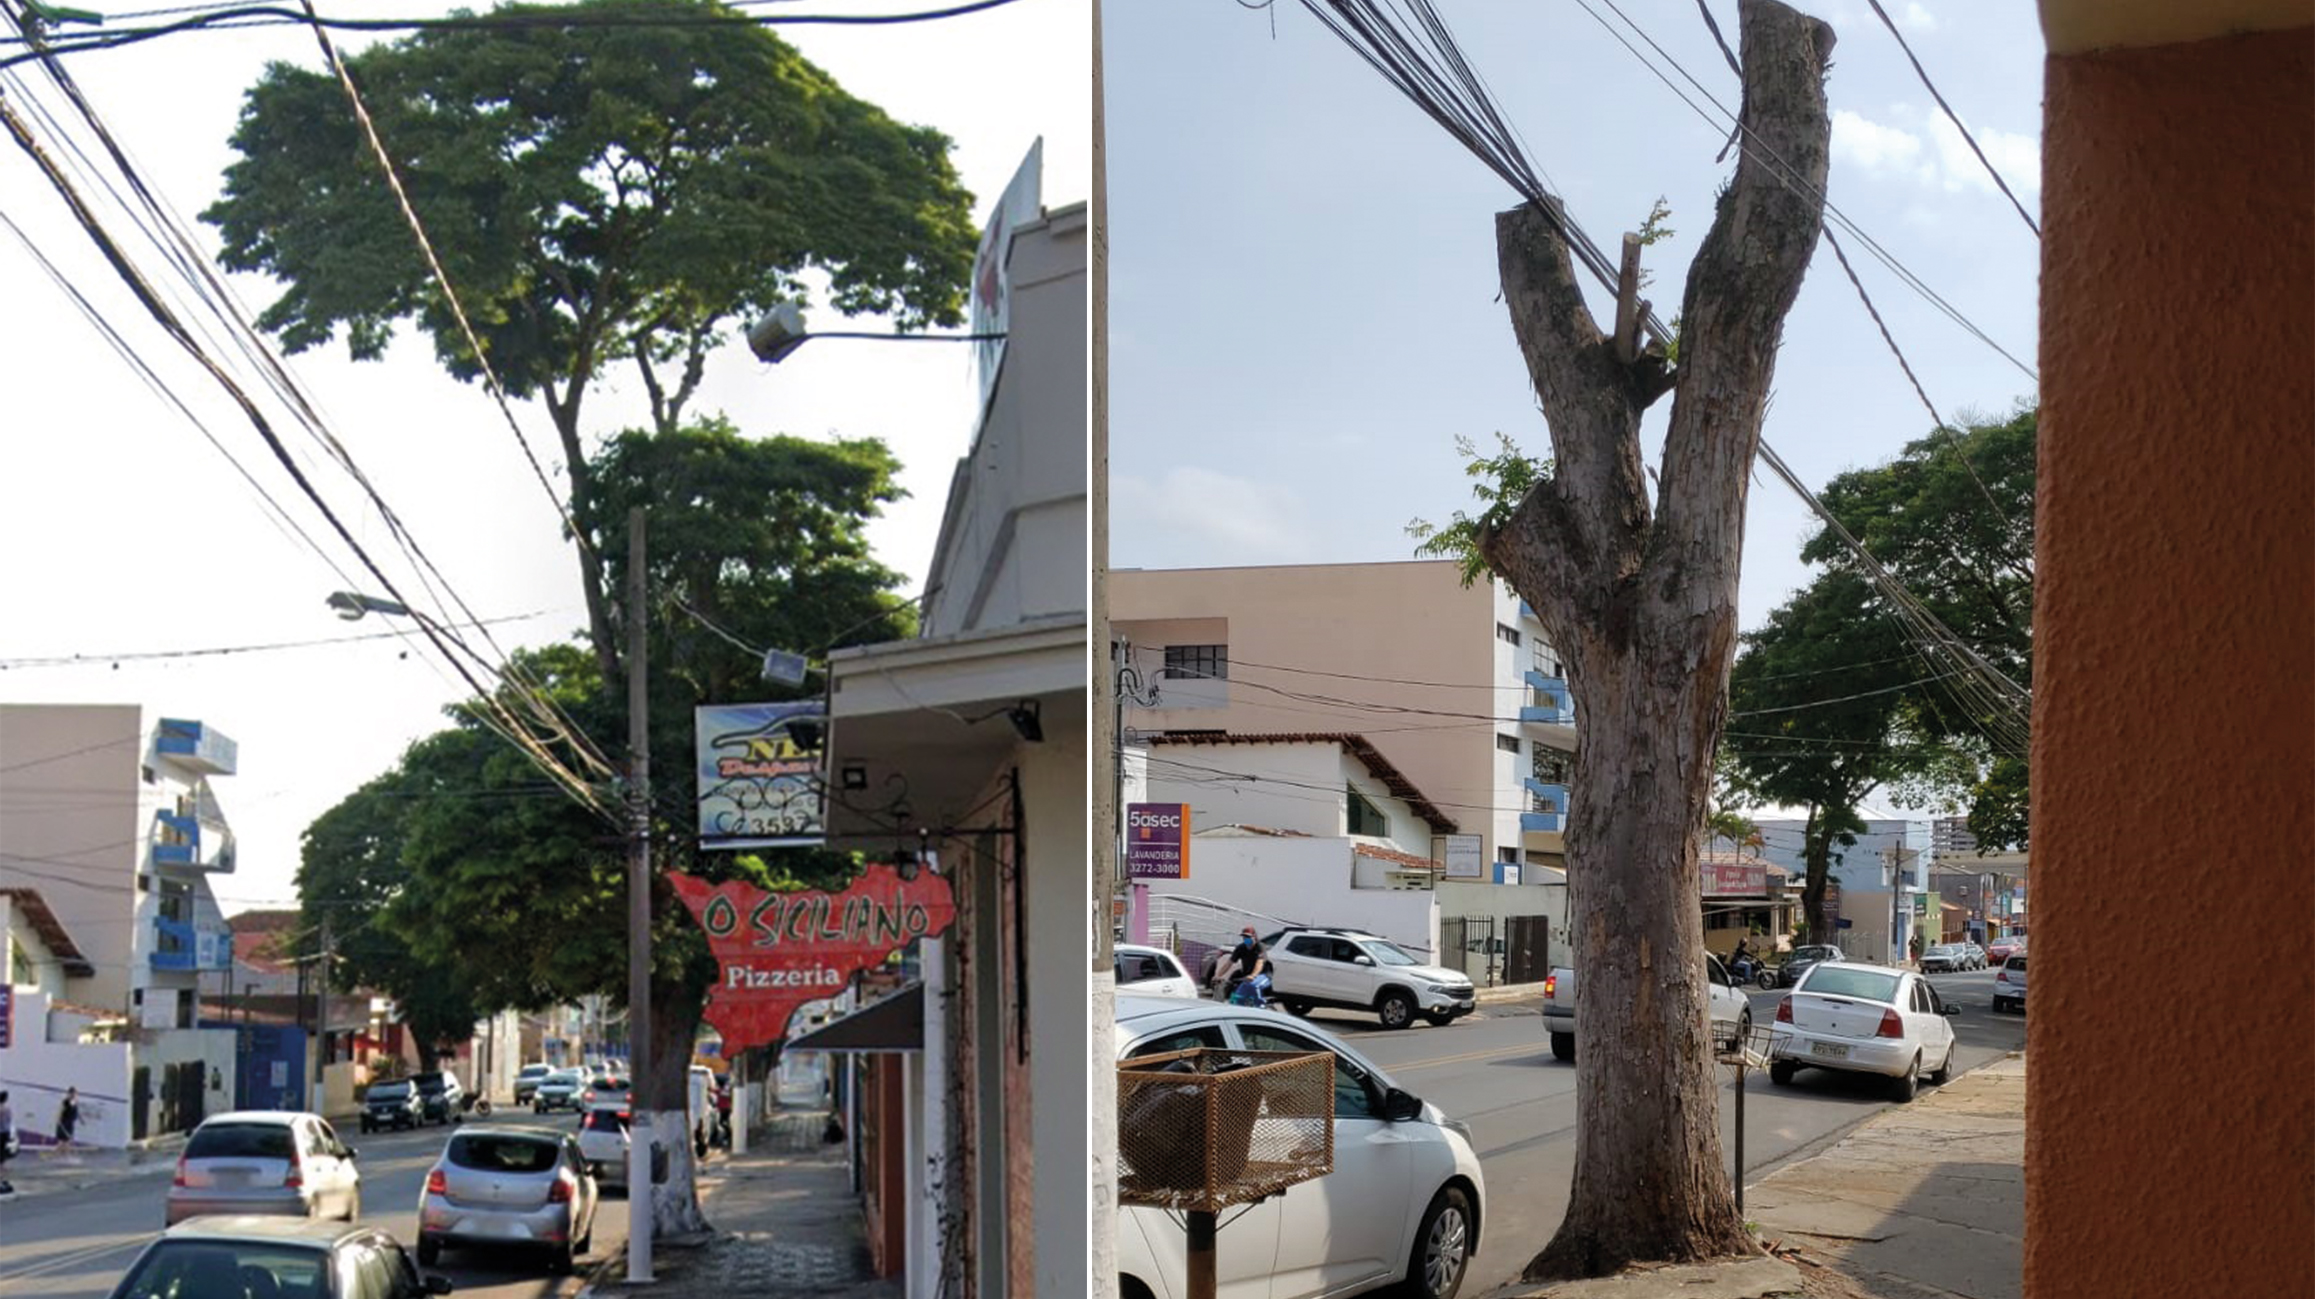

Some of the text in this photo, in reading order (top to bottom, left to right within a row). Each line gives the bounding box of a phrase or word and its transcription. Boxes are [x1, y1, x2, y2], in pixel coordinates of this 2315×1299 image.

[1129, 850, 1179, 860] LAVANDERIA
[1130, 862, 1180, 874] 3272-3000
[704, 889, 928, 945] O SICILIANO
[728, 964, 840, 988] Pizzeria
